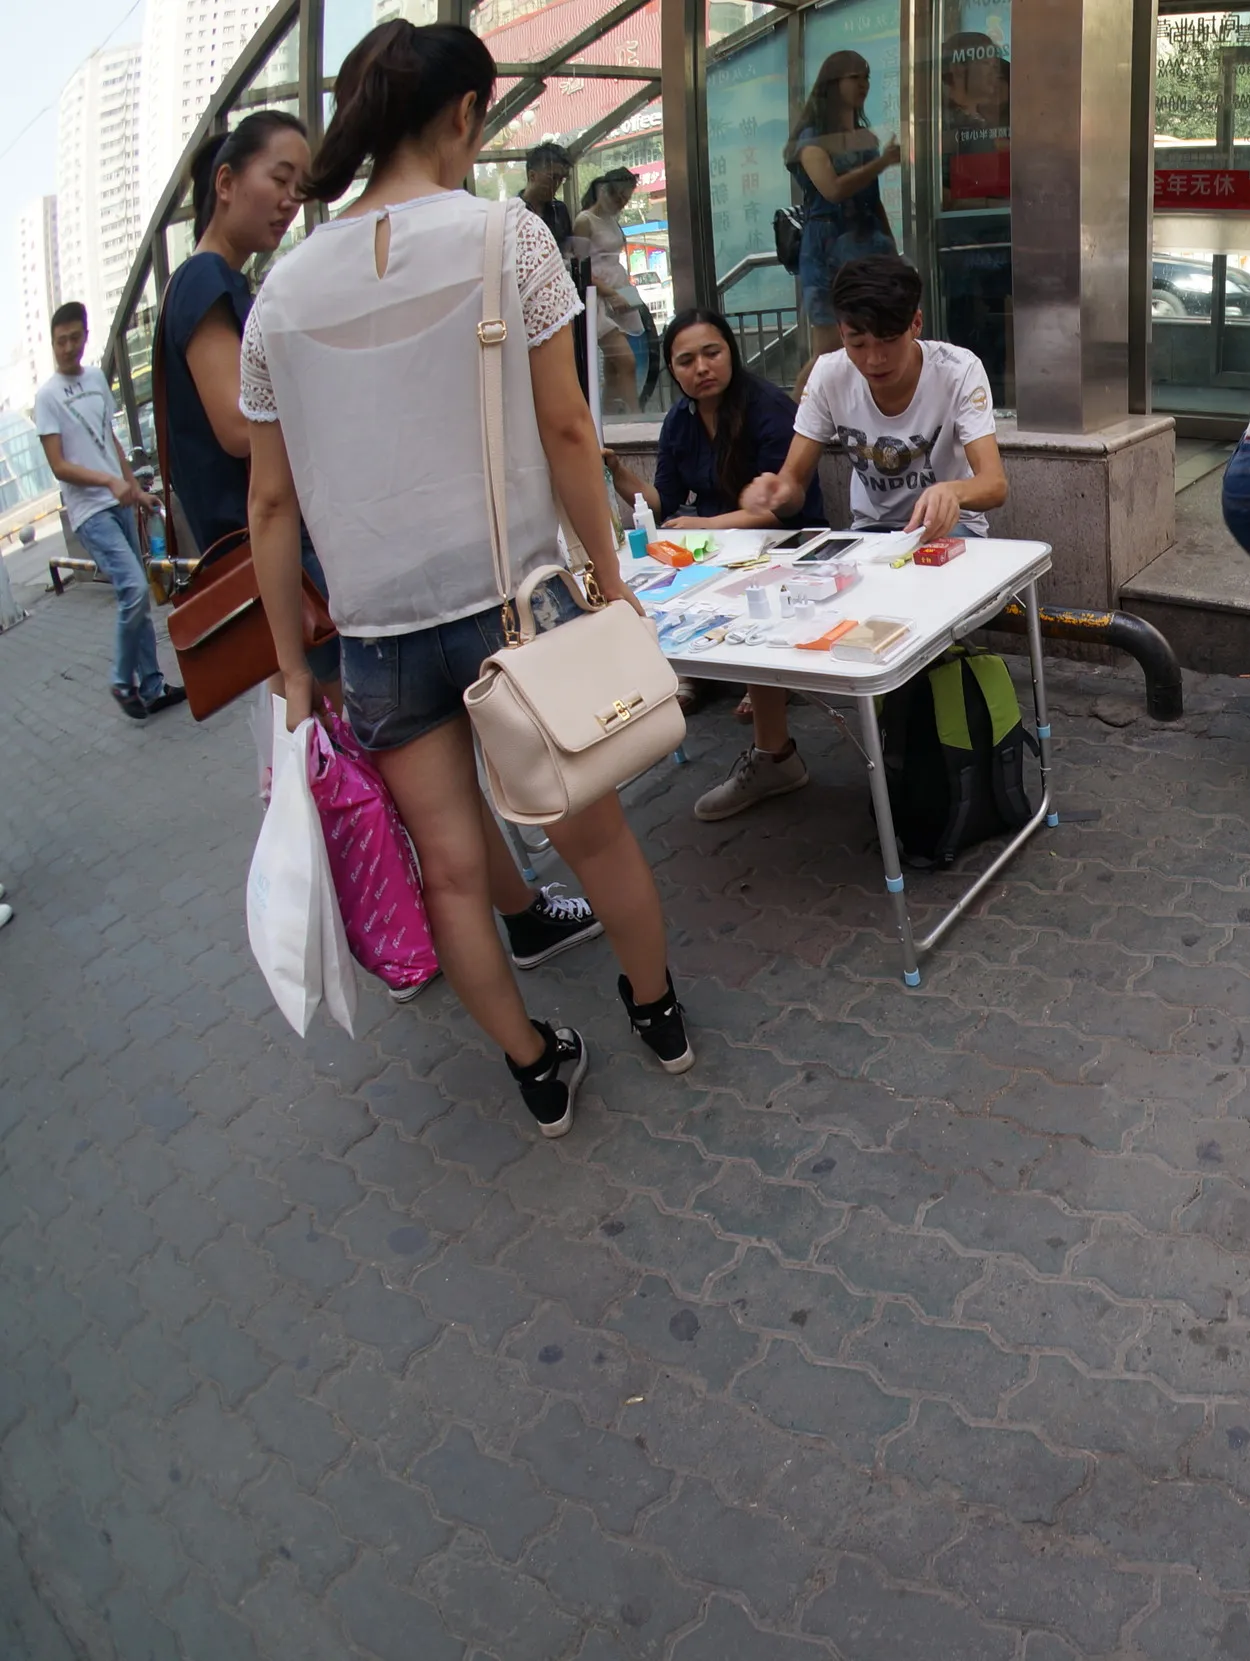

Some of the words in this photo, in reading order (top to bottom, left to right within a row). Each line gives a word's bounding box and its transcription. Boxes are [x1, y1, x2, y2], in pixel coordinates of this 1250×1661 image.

[1154, 173, 1236, 197] 全年无休
[838, 424, 943, 477] BOY
[856, 470, 937, 493] ONDON
